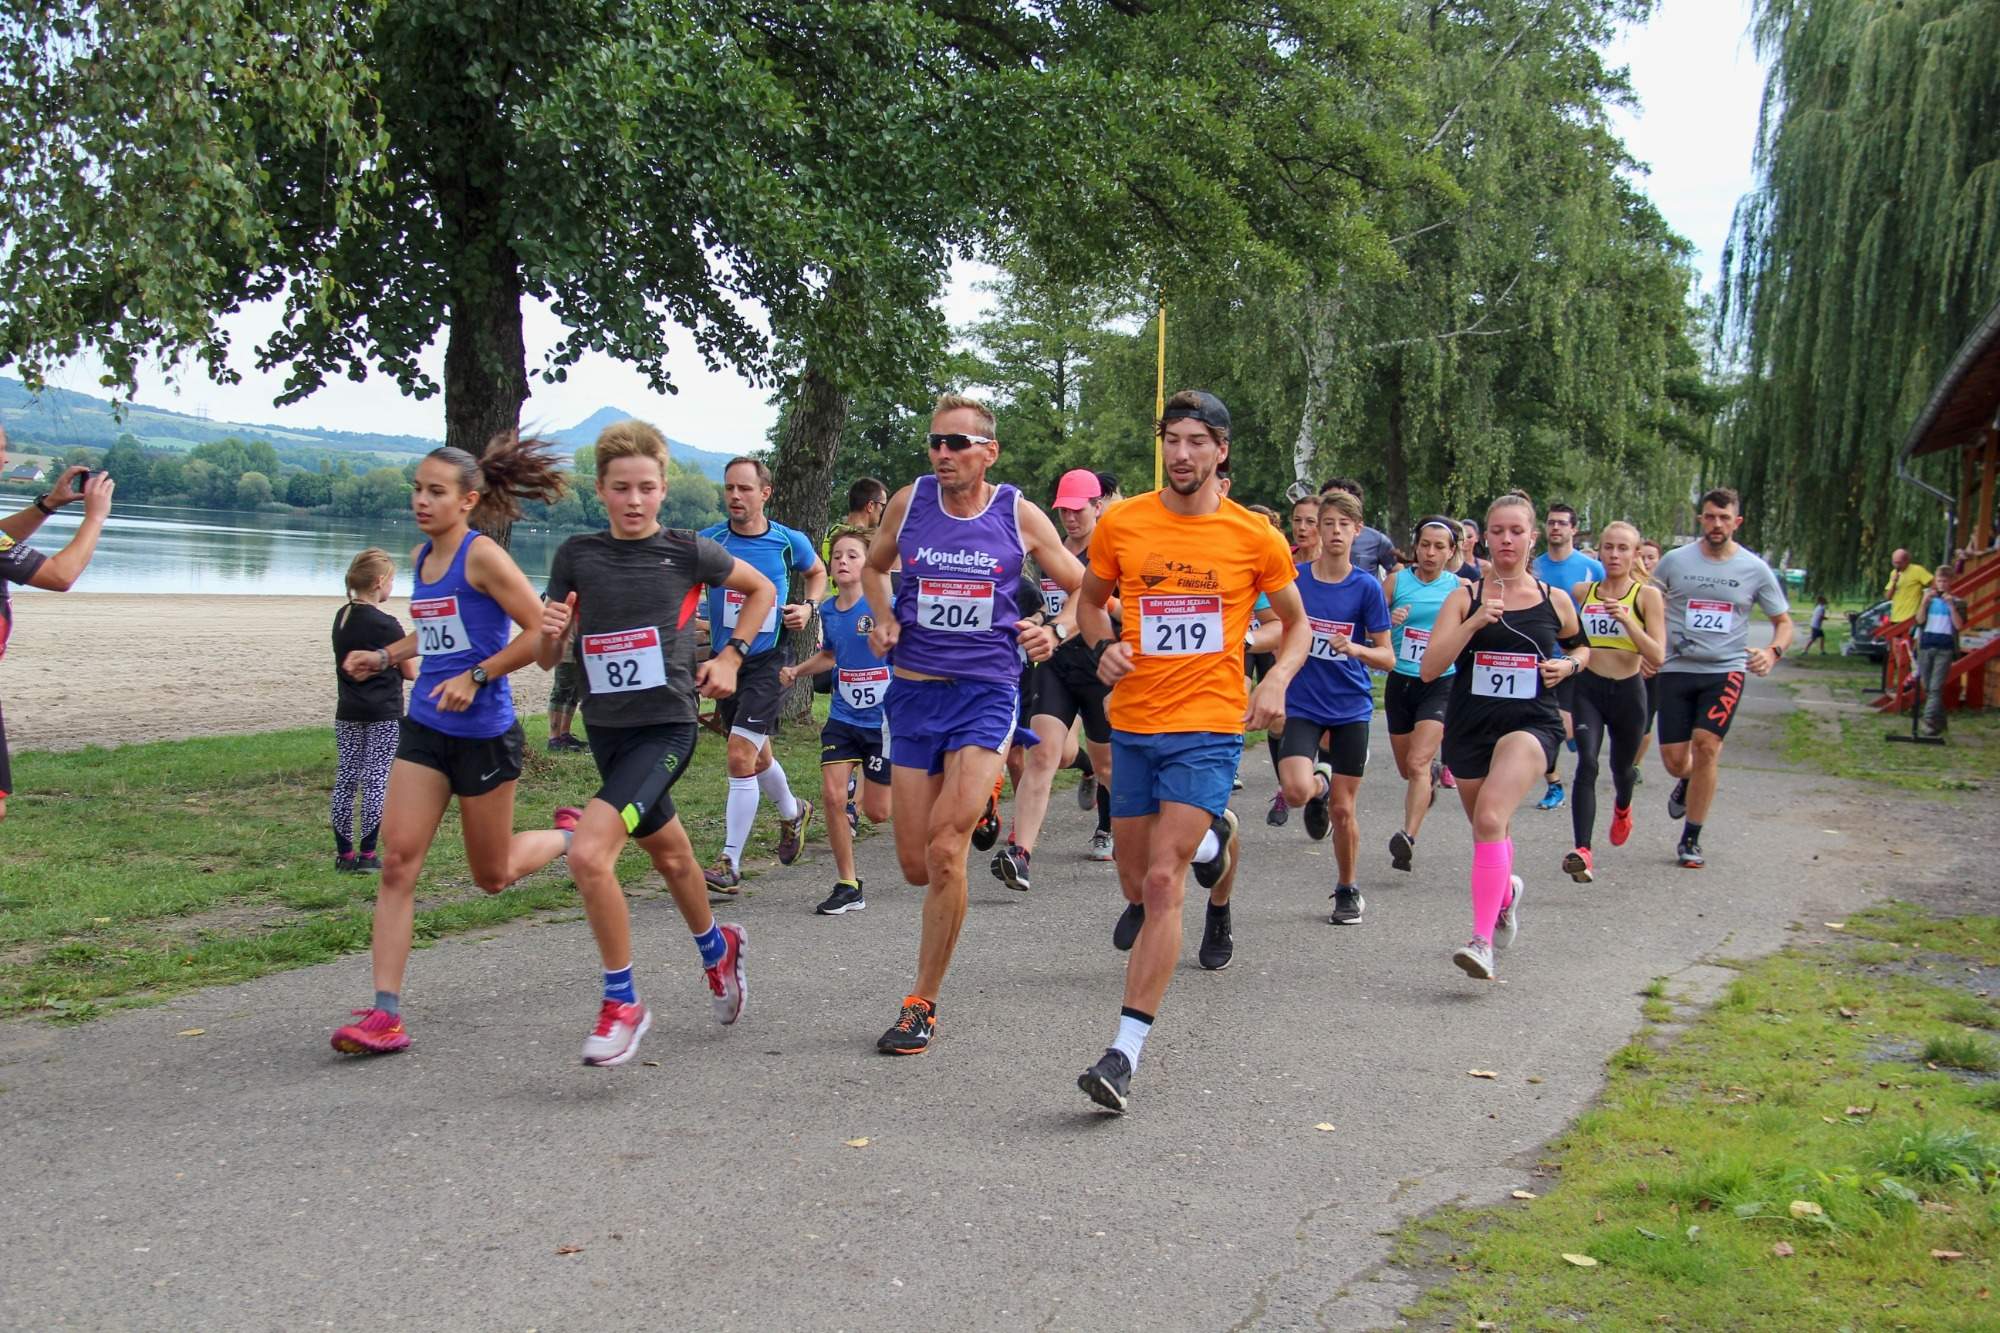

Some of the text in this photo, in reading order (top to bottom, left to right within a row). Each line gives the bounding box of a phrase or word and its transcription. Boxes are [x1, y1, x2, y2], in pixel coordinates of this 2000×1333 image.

[914, 547, 999, 568] Mondelēz
[939, 563, 991, 575] International
[1177, 578, 1219, 590] FINISHER
[1164, 599, 1186, 608] KOLEM
[930, 603, 980, 628] 204
[1693, 614, 1723, 629] 224
[1156, 622, 1207, 651] 219
[1590, 618, 1620, 636] 184
[422, 624, 456, 651] 206
[606, 659, 642, 688] 82
[1490, 673, 1515, 695] 91
[851, 687, 876, 706] 95
[868, 755, 883, 772] 23
